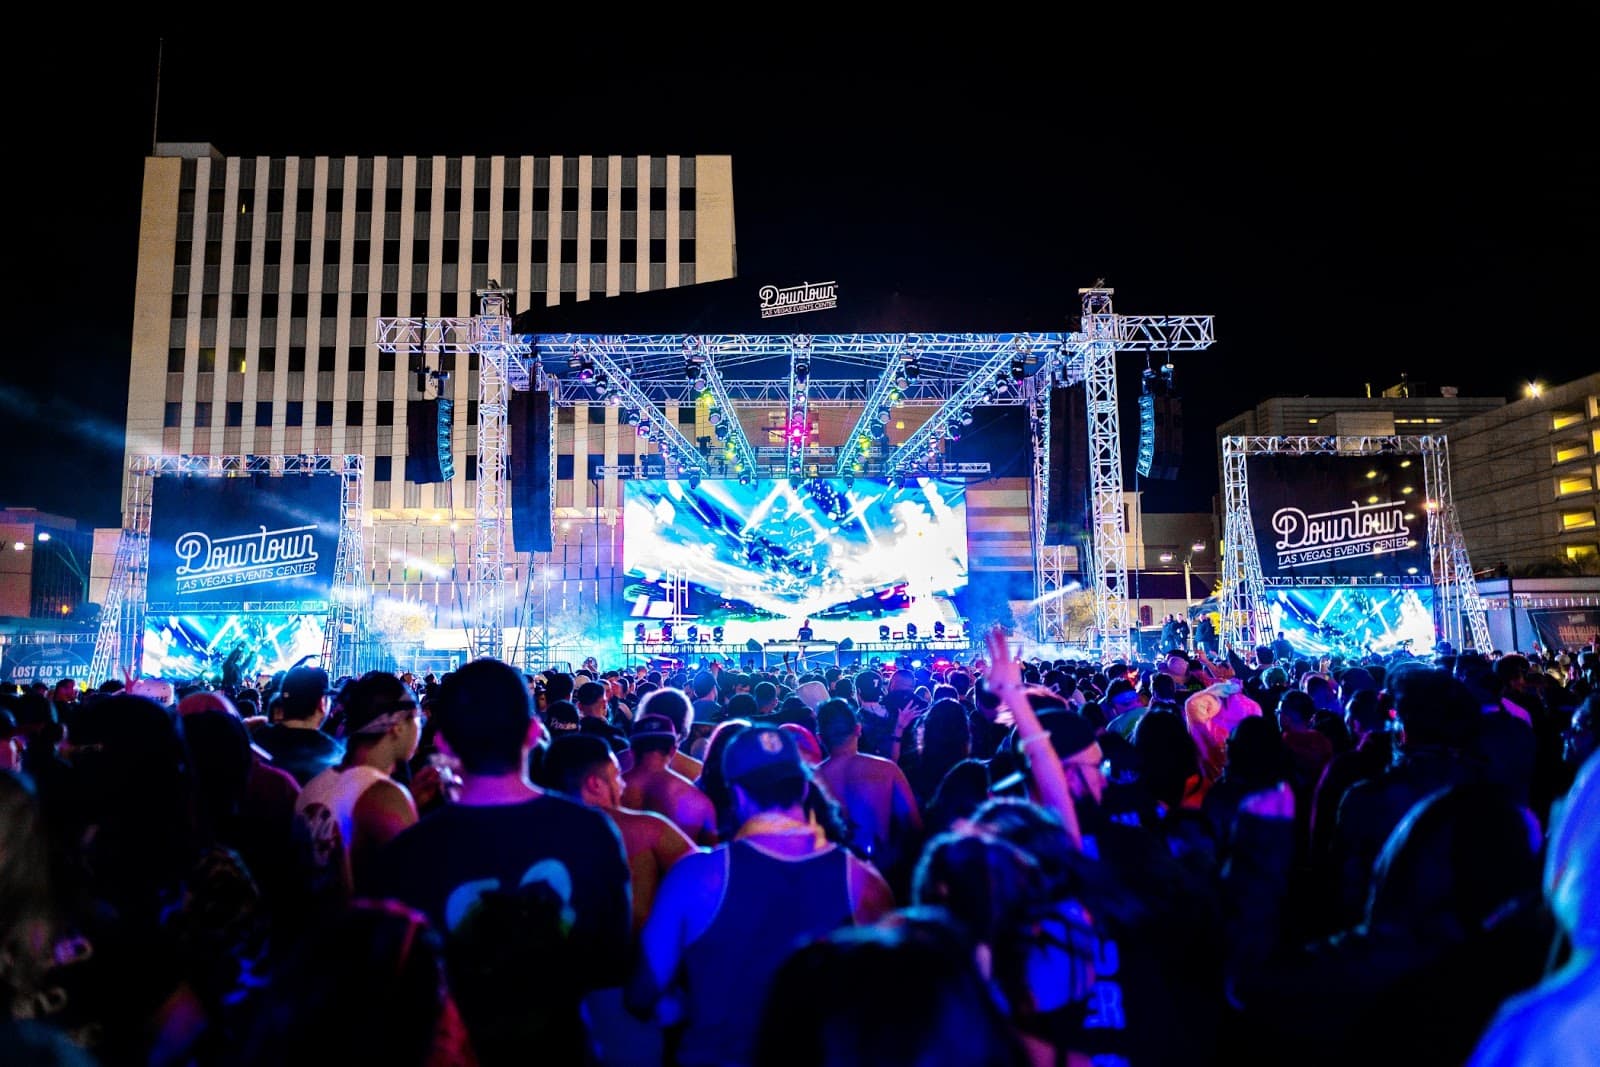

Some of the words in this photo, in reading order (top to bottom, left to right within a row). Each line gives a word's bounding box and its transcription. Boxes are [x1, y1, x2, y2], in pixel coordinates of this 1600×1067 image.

[759, 281, 838, 308] Downtown
[761, 308, 774, 317] LAS
[774, 306, 793, 315] VEGAS
[793, 303, 814, 312] EVENTS
[815, 301, 836, 310] CENTER
[1272, 500, 1410, 549] Downtown
[175, 525, 319, 574] Downtown
[1278, 554, 1297, 565] LAS
[1300, 549, 1332, 562] VEGAS
[1334, 542, 1371, 556] EVENTS
[1373, 537, 1409, 551] CENTER
[177, 580, 197, 591] LAS
[199, 574, 233, 587] VEGAS
[235, 568, 274, 582] EVENTS
[276, 562, 316, 576] CENTER
[12, 665, 37, 678] LOST
[39, 665, 63, 677] 80'S
[65, 664, 89, 676] LIVE
